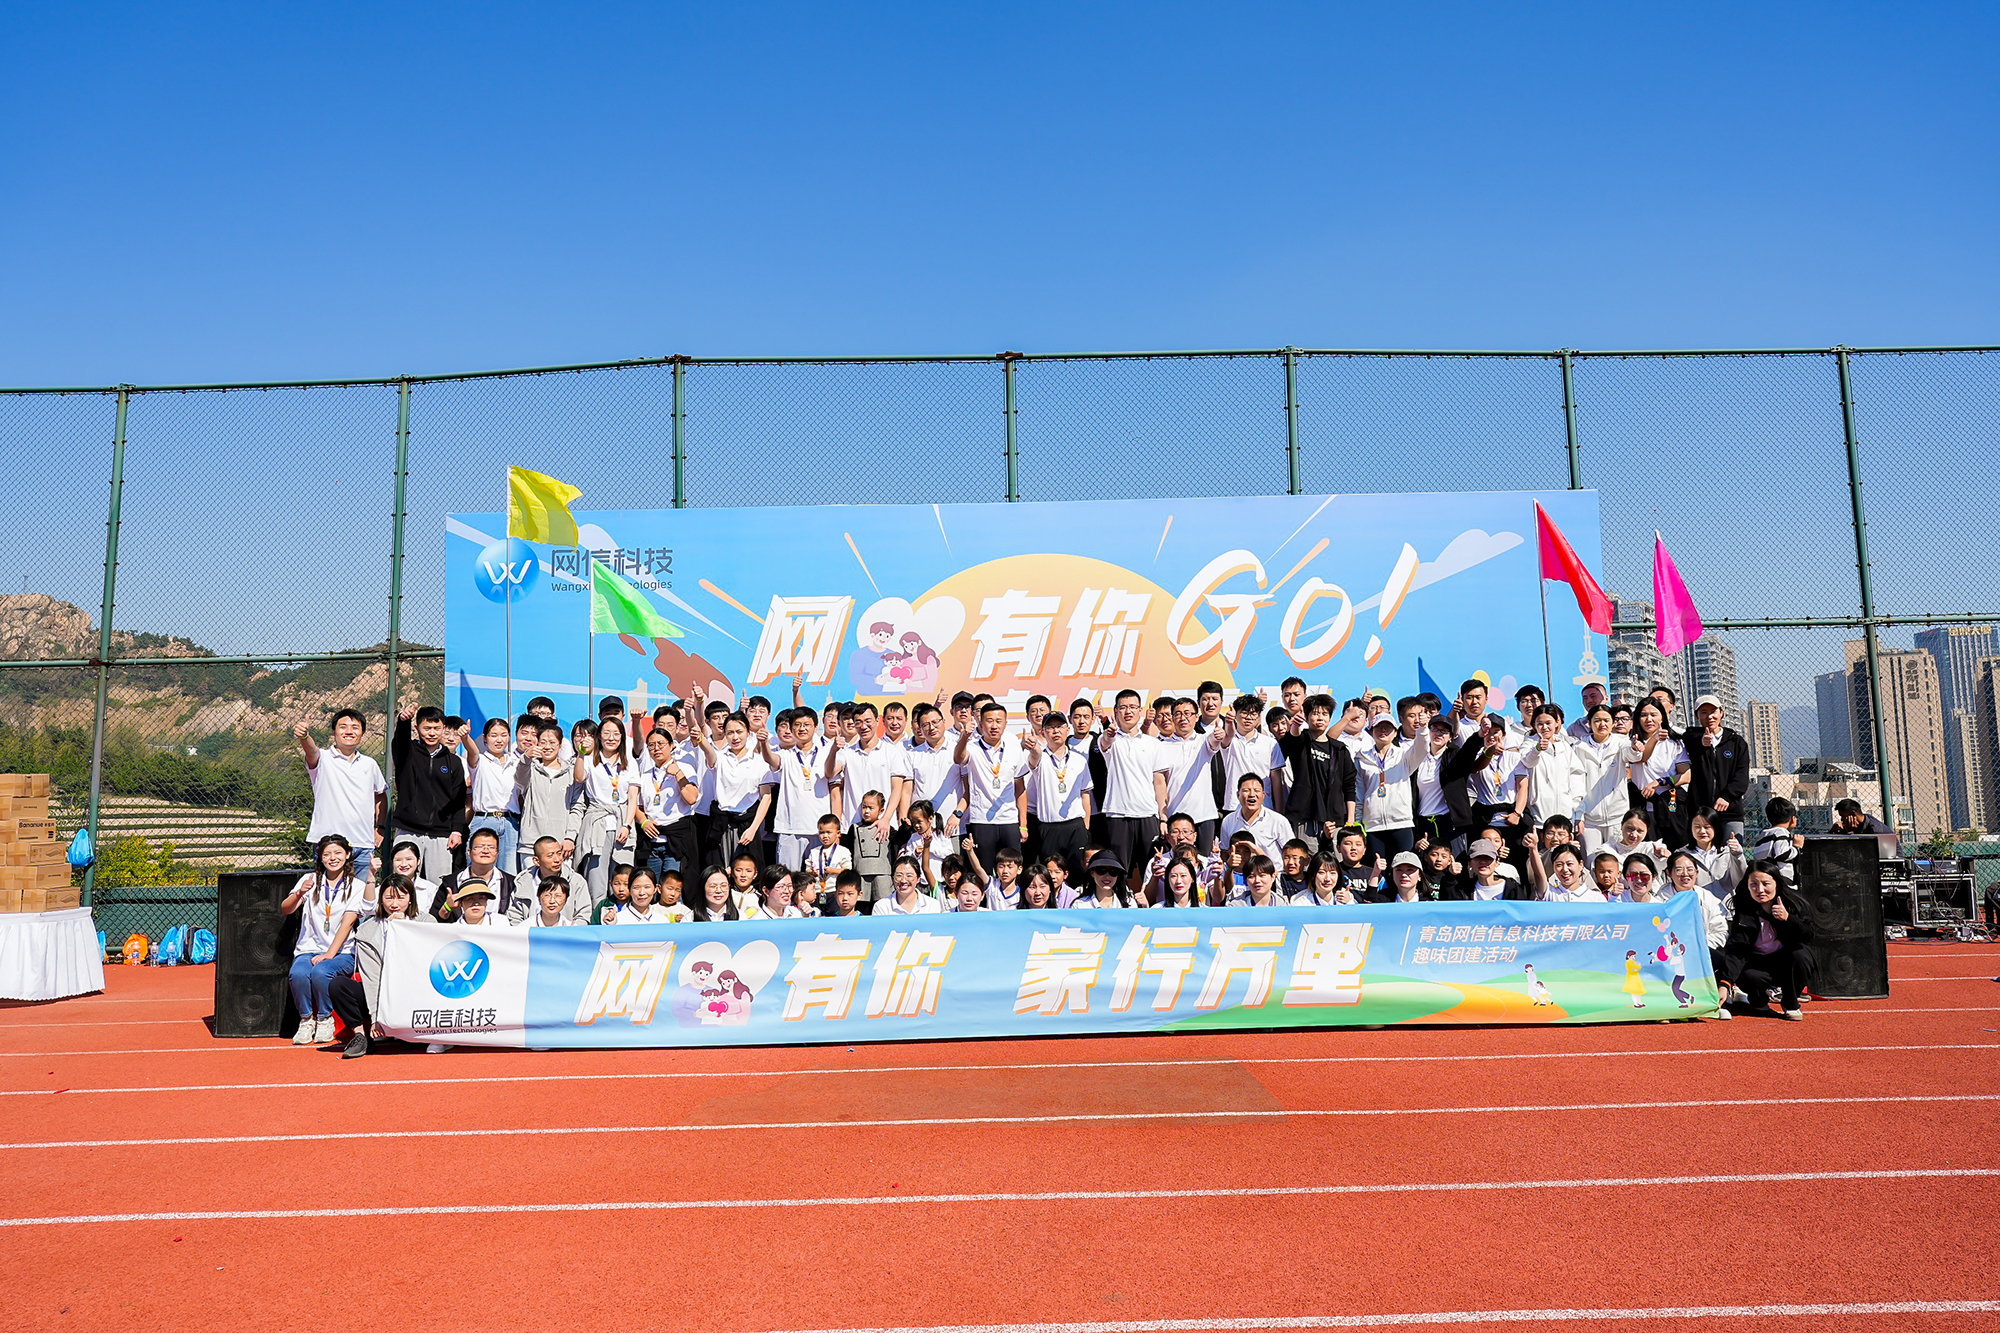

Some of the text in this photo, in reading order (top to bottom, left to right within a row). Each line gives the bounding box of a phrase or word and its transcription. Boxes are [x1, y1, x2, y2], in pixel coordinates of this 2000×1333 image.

[551, 547, 673, 577] 网信科技
[551, 581, 591, 593] Wangxi
[969, 587, 1154, 681] 有你
[1419, 923, 1631, 944] 青岛网信信息科技有限公司
[1411, 945, 1519, 965] 趣味团建活动
[781, 929, 957, 1022] 有你
[1012, 922, 1374, 1016] 家行万里
[411, 1007, 498, 1028] 网信科技
